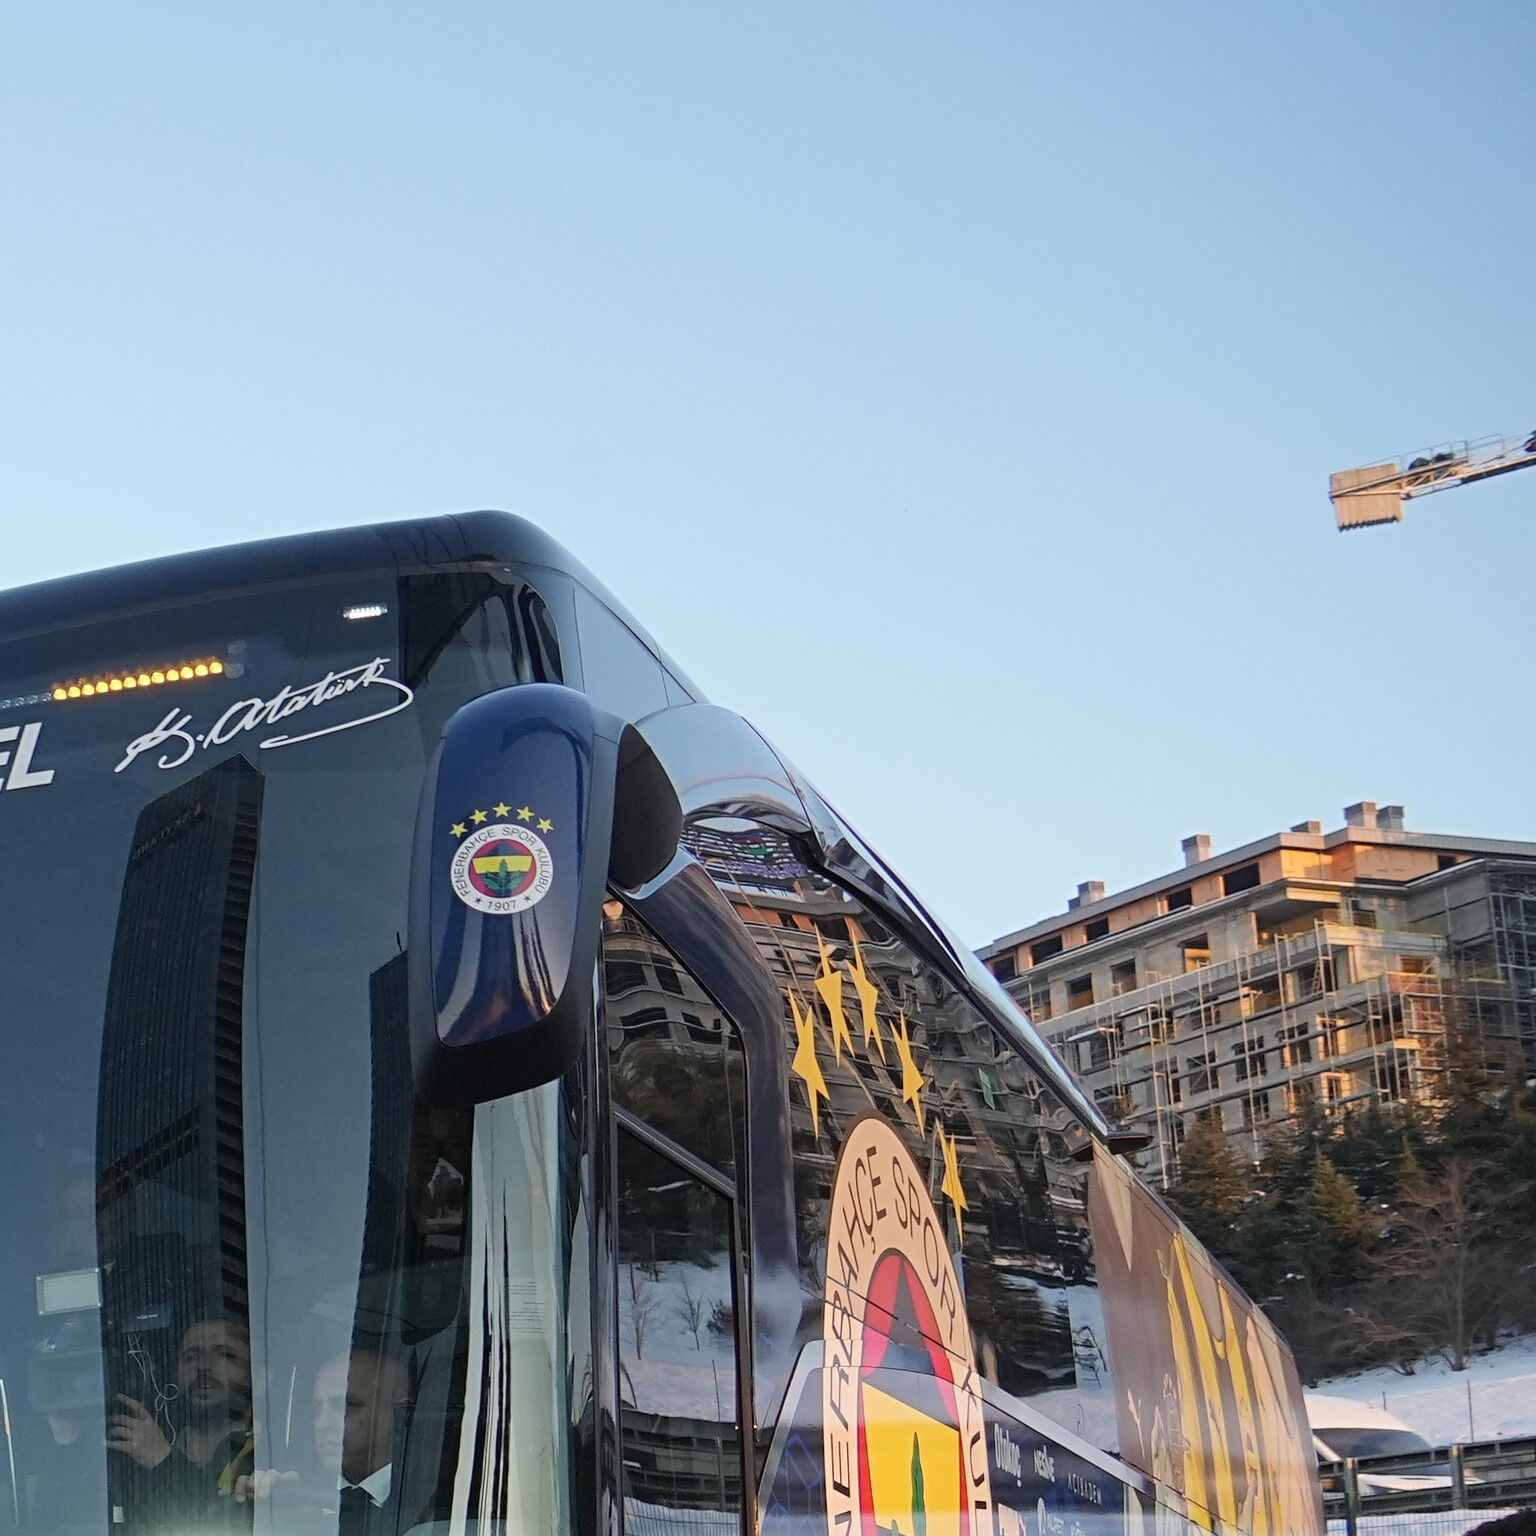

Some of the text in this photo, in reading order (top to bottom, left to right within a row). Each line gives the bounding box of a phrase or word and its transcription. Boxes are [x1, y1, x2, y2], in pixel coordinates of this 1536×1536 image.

[502, 827, 537, 846] SPOR
[488, 900, 516, 912] 1907
[893, 1156, 957, 1344] SPOR
